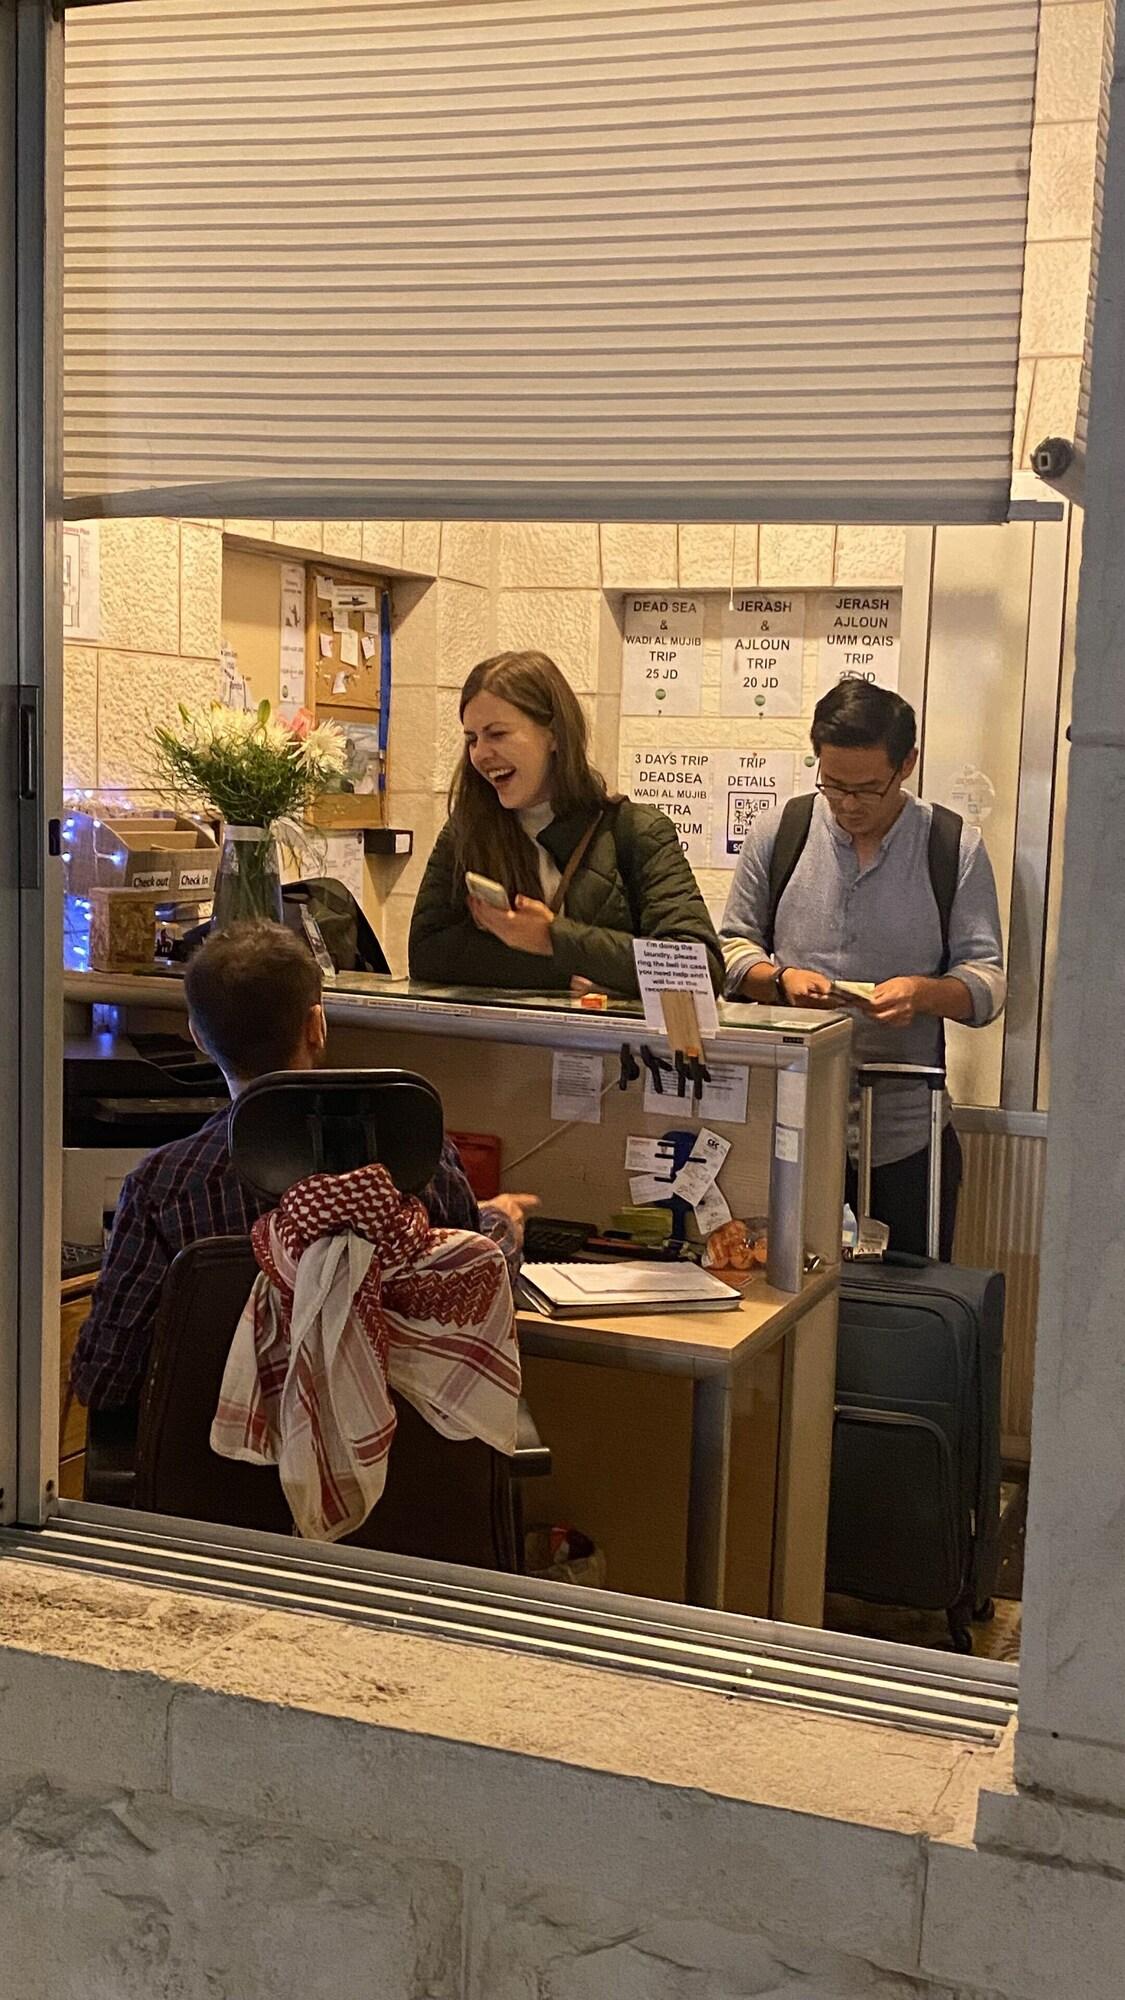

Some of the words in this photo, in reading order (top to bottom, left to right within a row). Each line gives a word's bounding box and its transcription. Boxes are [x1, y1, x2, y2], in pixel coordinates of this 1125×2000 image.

[633, 601, 668, 613] DEAD
[672, 601, 697, 613] SEA
[736, 600, 792, 613] JERASH
[835, 598, 889, 610] JERASH
[660, 619, 668, 631] &
[760, 620, 770, 632] &
[833, 616, 888, 629] AJLOUN
[625, 635, 652, 645] WADI
[654, 636, 667, 645] AL
[670, 637, 702, 647] MUJIB
[734, 638, 790, 651] AJLOUN
[826, 634, 858, 646] UMM
[861, 634, 894, 647] QAIS
[649, 650, 677, 662] TRIP
[843, 652, 874, 664] TRIP
[746, 657, 777, 669] TRIP
[646, 668, 660, 679] 25
[662, 669, 678, 680] JD
[743, 676, 758, 688] 20
[761, 677, 779, 689] JD
[635, 753, 641, 764] 3
[645, 753, 677, 765] DAYS
[681, 755, 709, 766] TRIP
[740, 757, 766, 768] TRIP
[639, 771, 703, 784] DEADSEA
[728, 775, 776, 787] DETAILS
[634, 788, 659, 797] WADI
[661, 789, 673, 798] AL
[677, 790, 707, 799] MUJIB
[134, 875, 155, 888] Check
[156, 877, 169, 887] out
[181, 874, 200, 886] Check
[202, 874, 209, 885] in
[659, 942, 680, 951] doing
[681, 943, 693, 951] the
[637, 959, 652, 968] ring
[653, 960, 665, 968] the
[666, 961, 679, 969] bell
[680, 961, 689, 969] in
